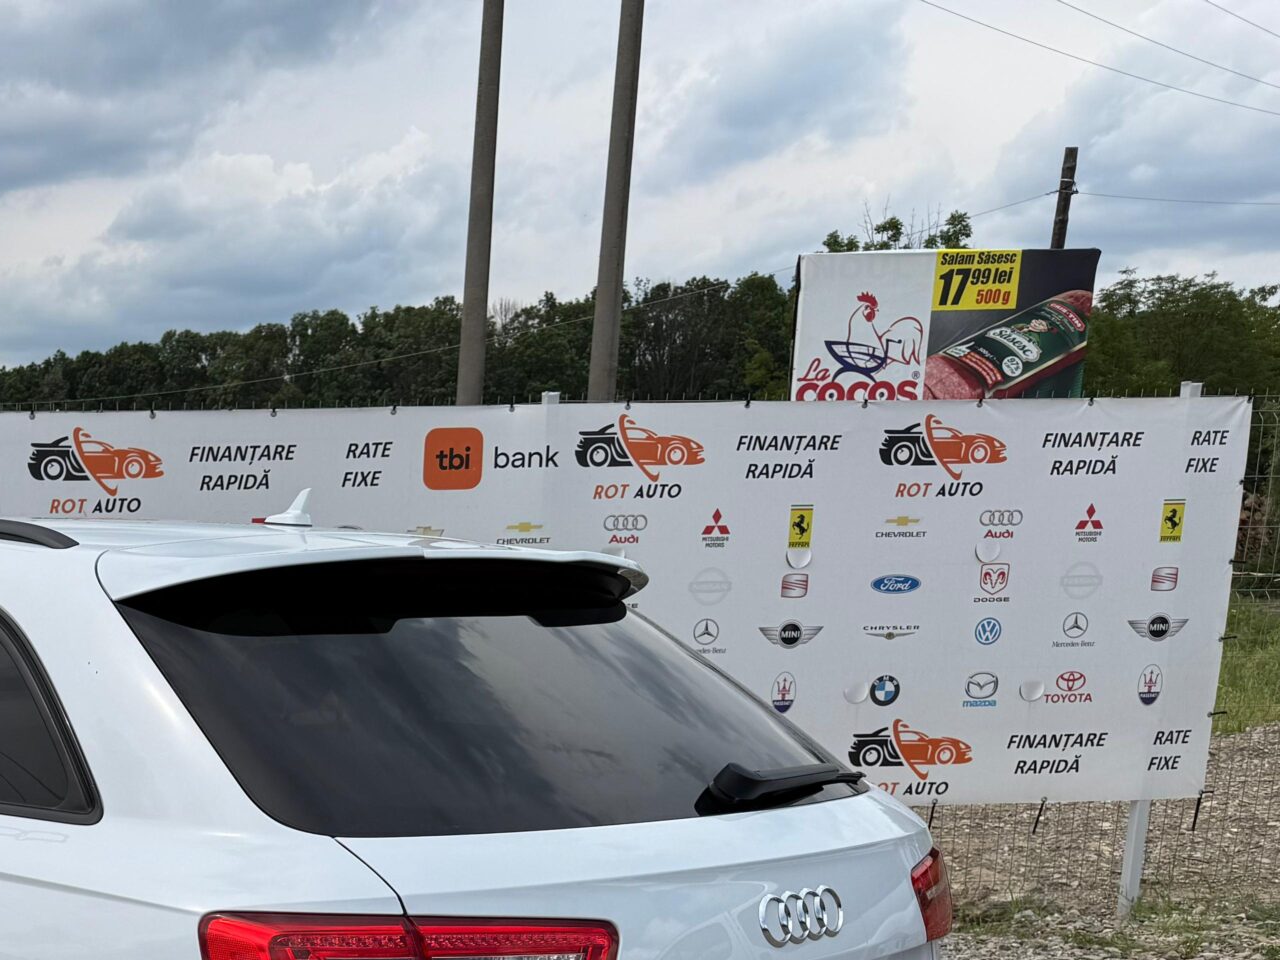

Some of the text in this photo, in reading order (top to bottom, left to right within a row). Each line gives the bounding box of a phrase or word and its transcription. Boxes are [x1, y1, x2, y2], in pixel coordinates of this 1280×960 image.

[941, 251, 1017, 265] Salam Săsesc
[992, 267, 1014, 284] lei
[976, 289, 1011, 305] 500 g
[797, 358, 830, 381] La
[736, 434, 842, 454] FINANȚARE
[1042, 432, 1144, 450] FINANȚARE
[1191, 430, 1229, 446] RATE
[189, 444, 297, 465] FINANȚARE
[346, 441, 393, 459] RATE
[436, 445, 559, 470] tbi bank
[745, 459, 815, 479] RAPIDĂ
[1050, 455, 1119, 475] RAPIDĂ
[1185, 457, 1219, 473] FIXE
[199, 469, 271, 491] RAPIDĂ
[342, 471, 382, 488] FIXE
[592, 484, 682, 500] ROT AUTO
[895, 482, 983, 498] ROT AUTO
[49, 498, 141, 514] ROT AUTO
[496, 537, 551, 545] CHEVROLET
[608, 534, 639, 544] Audi
[875, 530, 927, 538] CHEVROLET
[984, 529, 1014, 539] Audi
[880, 576, 913, 591] Ford
[781, 630, 801, 639] MINI
[1149, 623, 1169, 632] MINI
[1044, 693, 1093, 703] TOYOTA
[1007, 732, 1108, 751] FINANȚARE
[1153, 729, 1192, 745] RATE
[1014, 755, 1081, 774] RAPIDĂ
[1147, 756, 1181, 771] FIXE
[903, 782, 949, 795] AUTO
